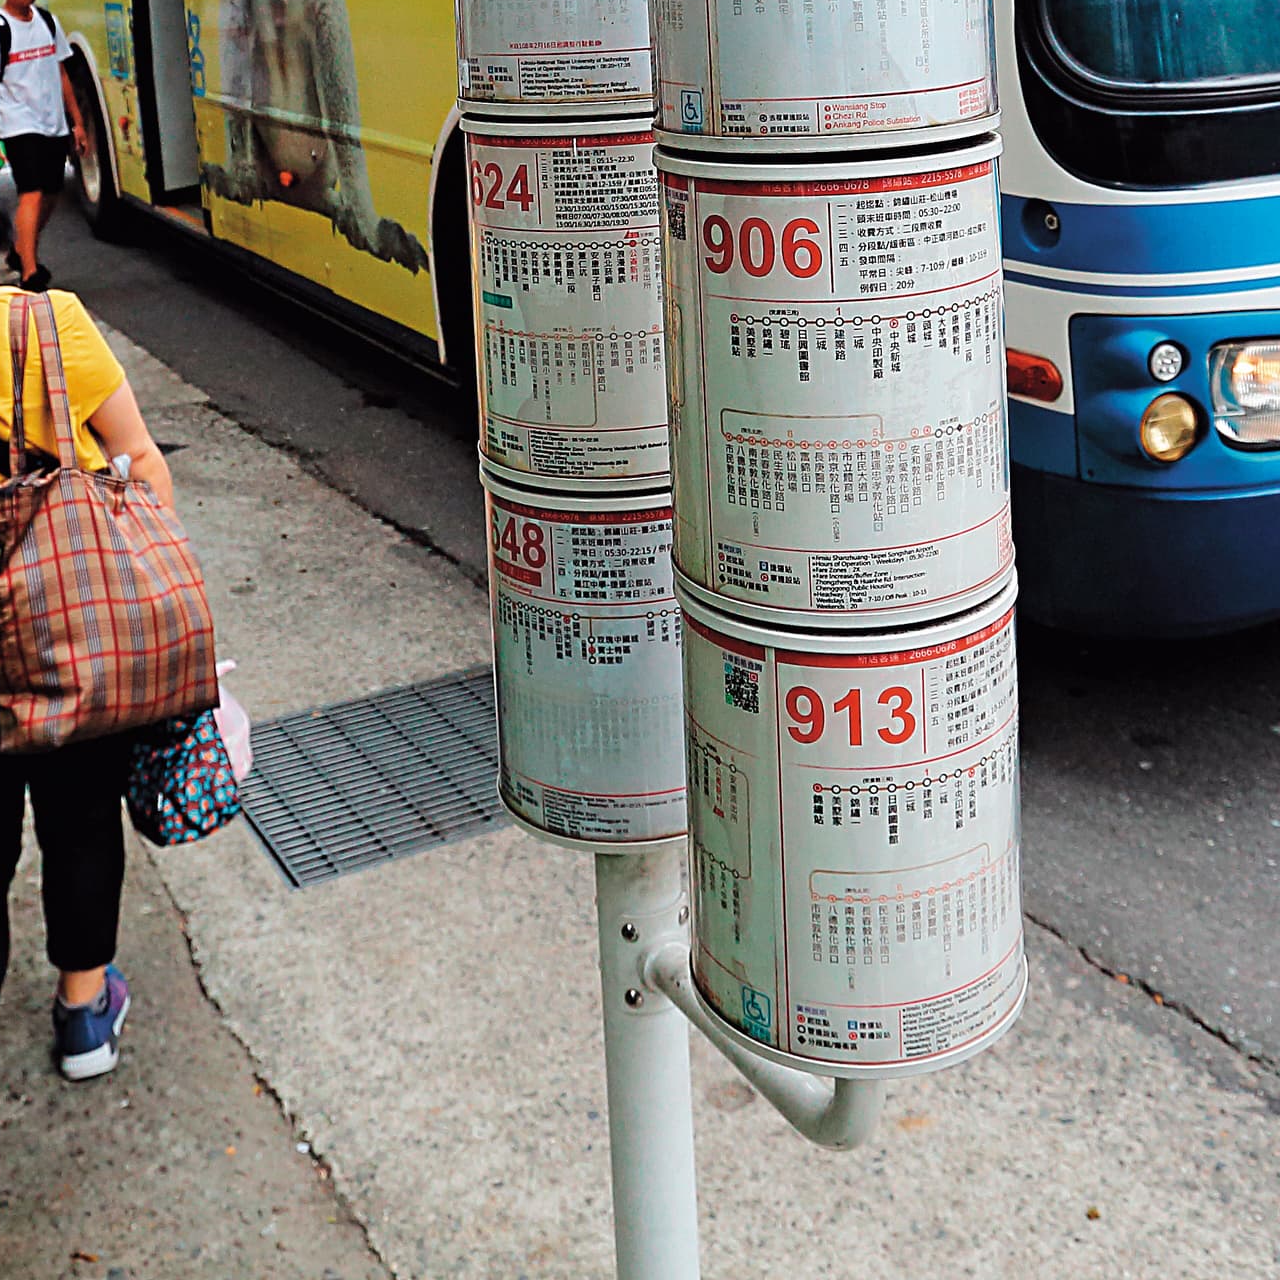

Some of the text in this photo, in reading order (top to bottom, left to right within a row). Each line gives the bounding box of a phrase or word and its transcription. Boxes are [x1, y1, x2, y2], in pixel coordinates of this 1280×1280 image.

[471, 160, 534, 212] 624
[703, 214, 822, 278] 906
[890, 331, 901, 373] 中央新城
[786, 686, 916, 747] 913
